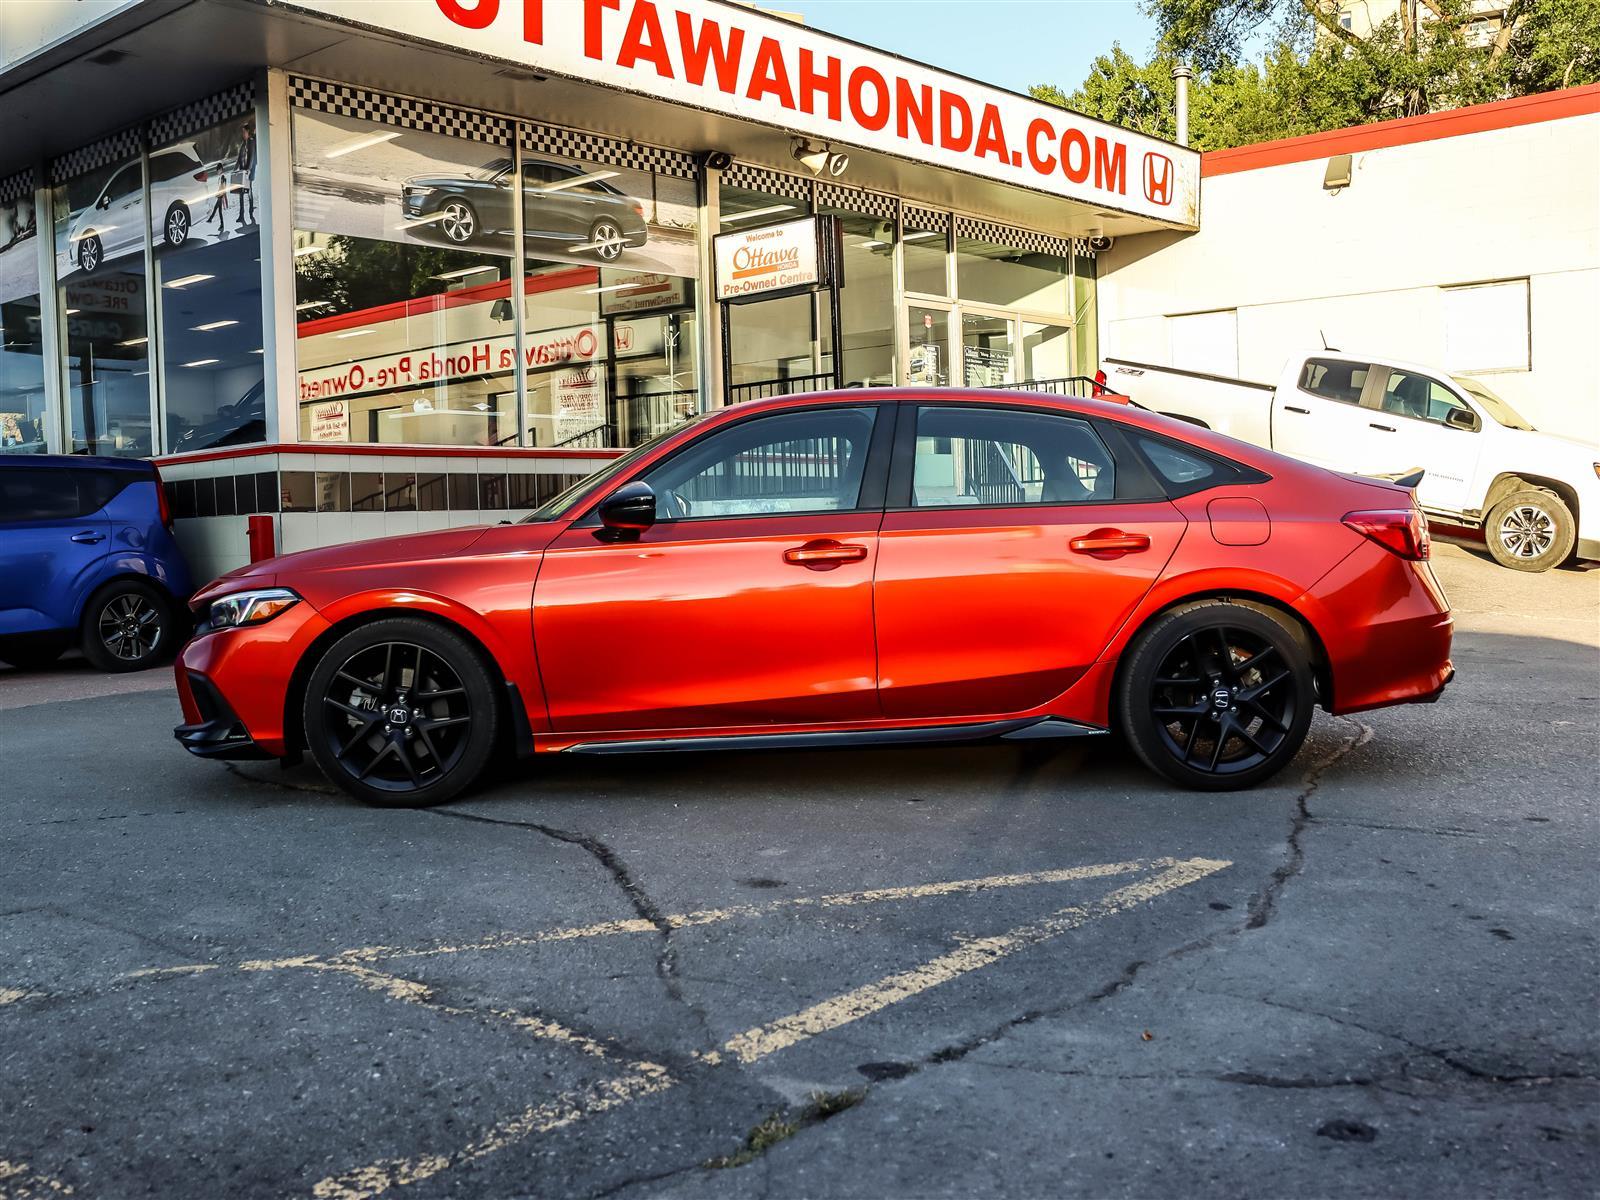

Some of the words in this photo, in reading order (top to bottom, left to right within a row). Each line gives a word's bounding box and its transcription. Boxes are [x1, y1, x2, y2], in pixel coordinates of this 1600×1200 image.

[746, 232, 775, 243] Welcome
[733, 246, 799, 271] Ottawa
[724, 277, 777, 295] Pre-Owned
